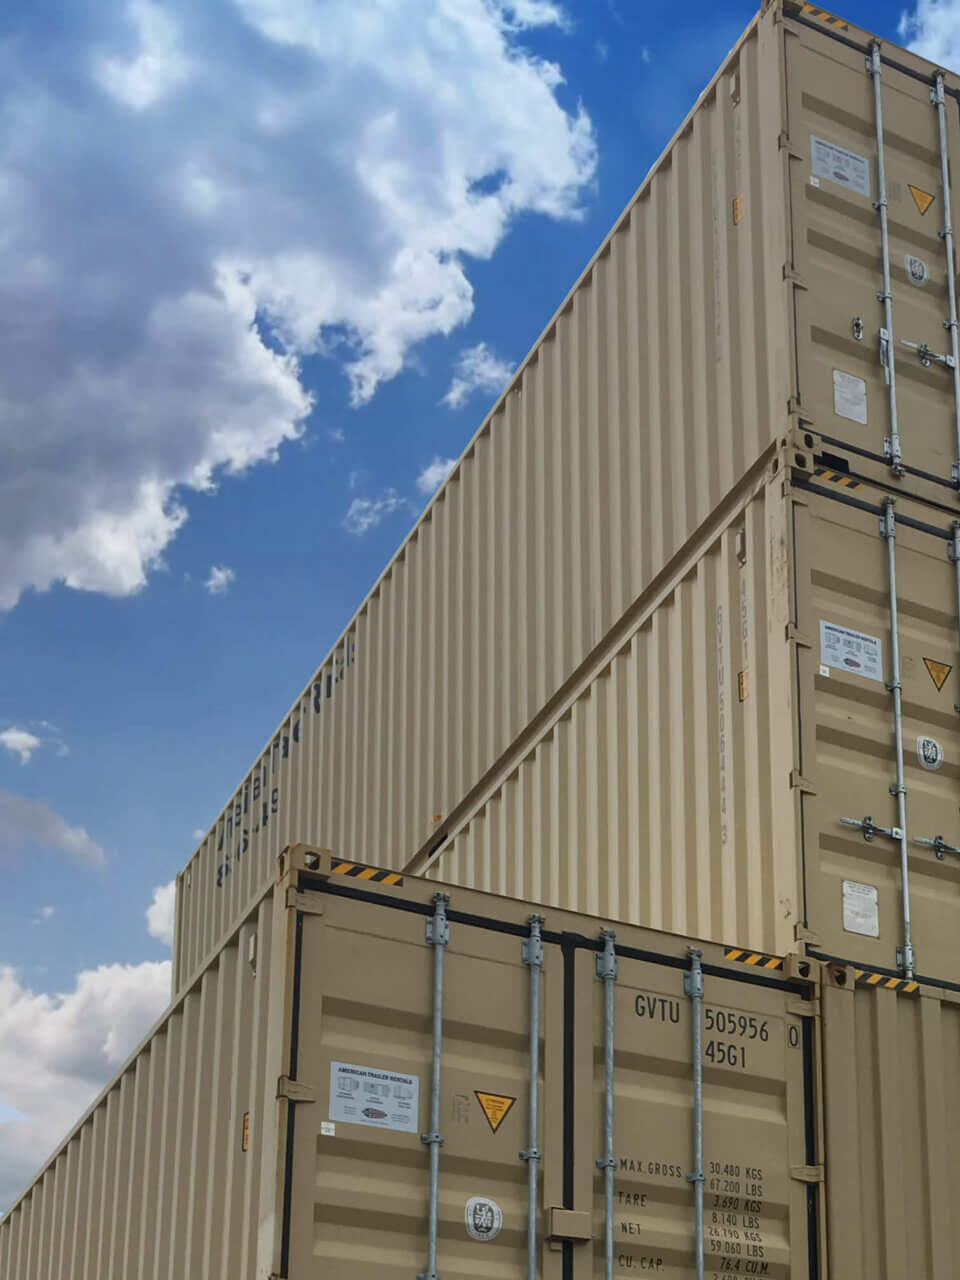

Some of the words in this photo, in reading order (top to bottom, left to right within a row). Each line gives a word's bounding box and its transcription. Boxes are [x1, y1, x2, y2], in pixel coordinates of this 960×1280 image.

[634, 994, 680, 1024] GVTU
[704, 1008, 769, 1042] 505956
[787, 1025, 799, 1048] 0
[704, 1038, 746, 1069] 45G1
[647, 1161, 682, 1178] GROSS
[709, 1161, 741, 1178] 30.480
[745, 1167, 762, 1181] KGS
[745, 1183, 762, 1197] LBS
[617, 1191, 648, 1207] TARE
[743, 1199, 762, 1214] KGS
[620, 1221, 641, 1236] NET
[742, 1215, 760, 1229] LBS
[744, 1231, 762, 1243] KGS
[747, 1243, 765, 1258] LBS
[640, 1255, 665, 1272] CAP.
